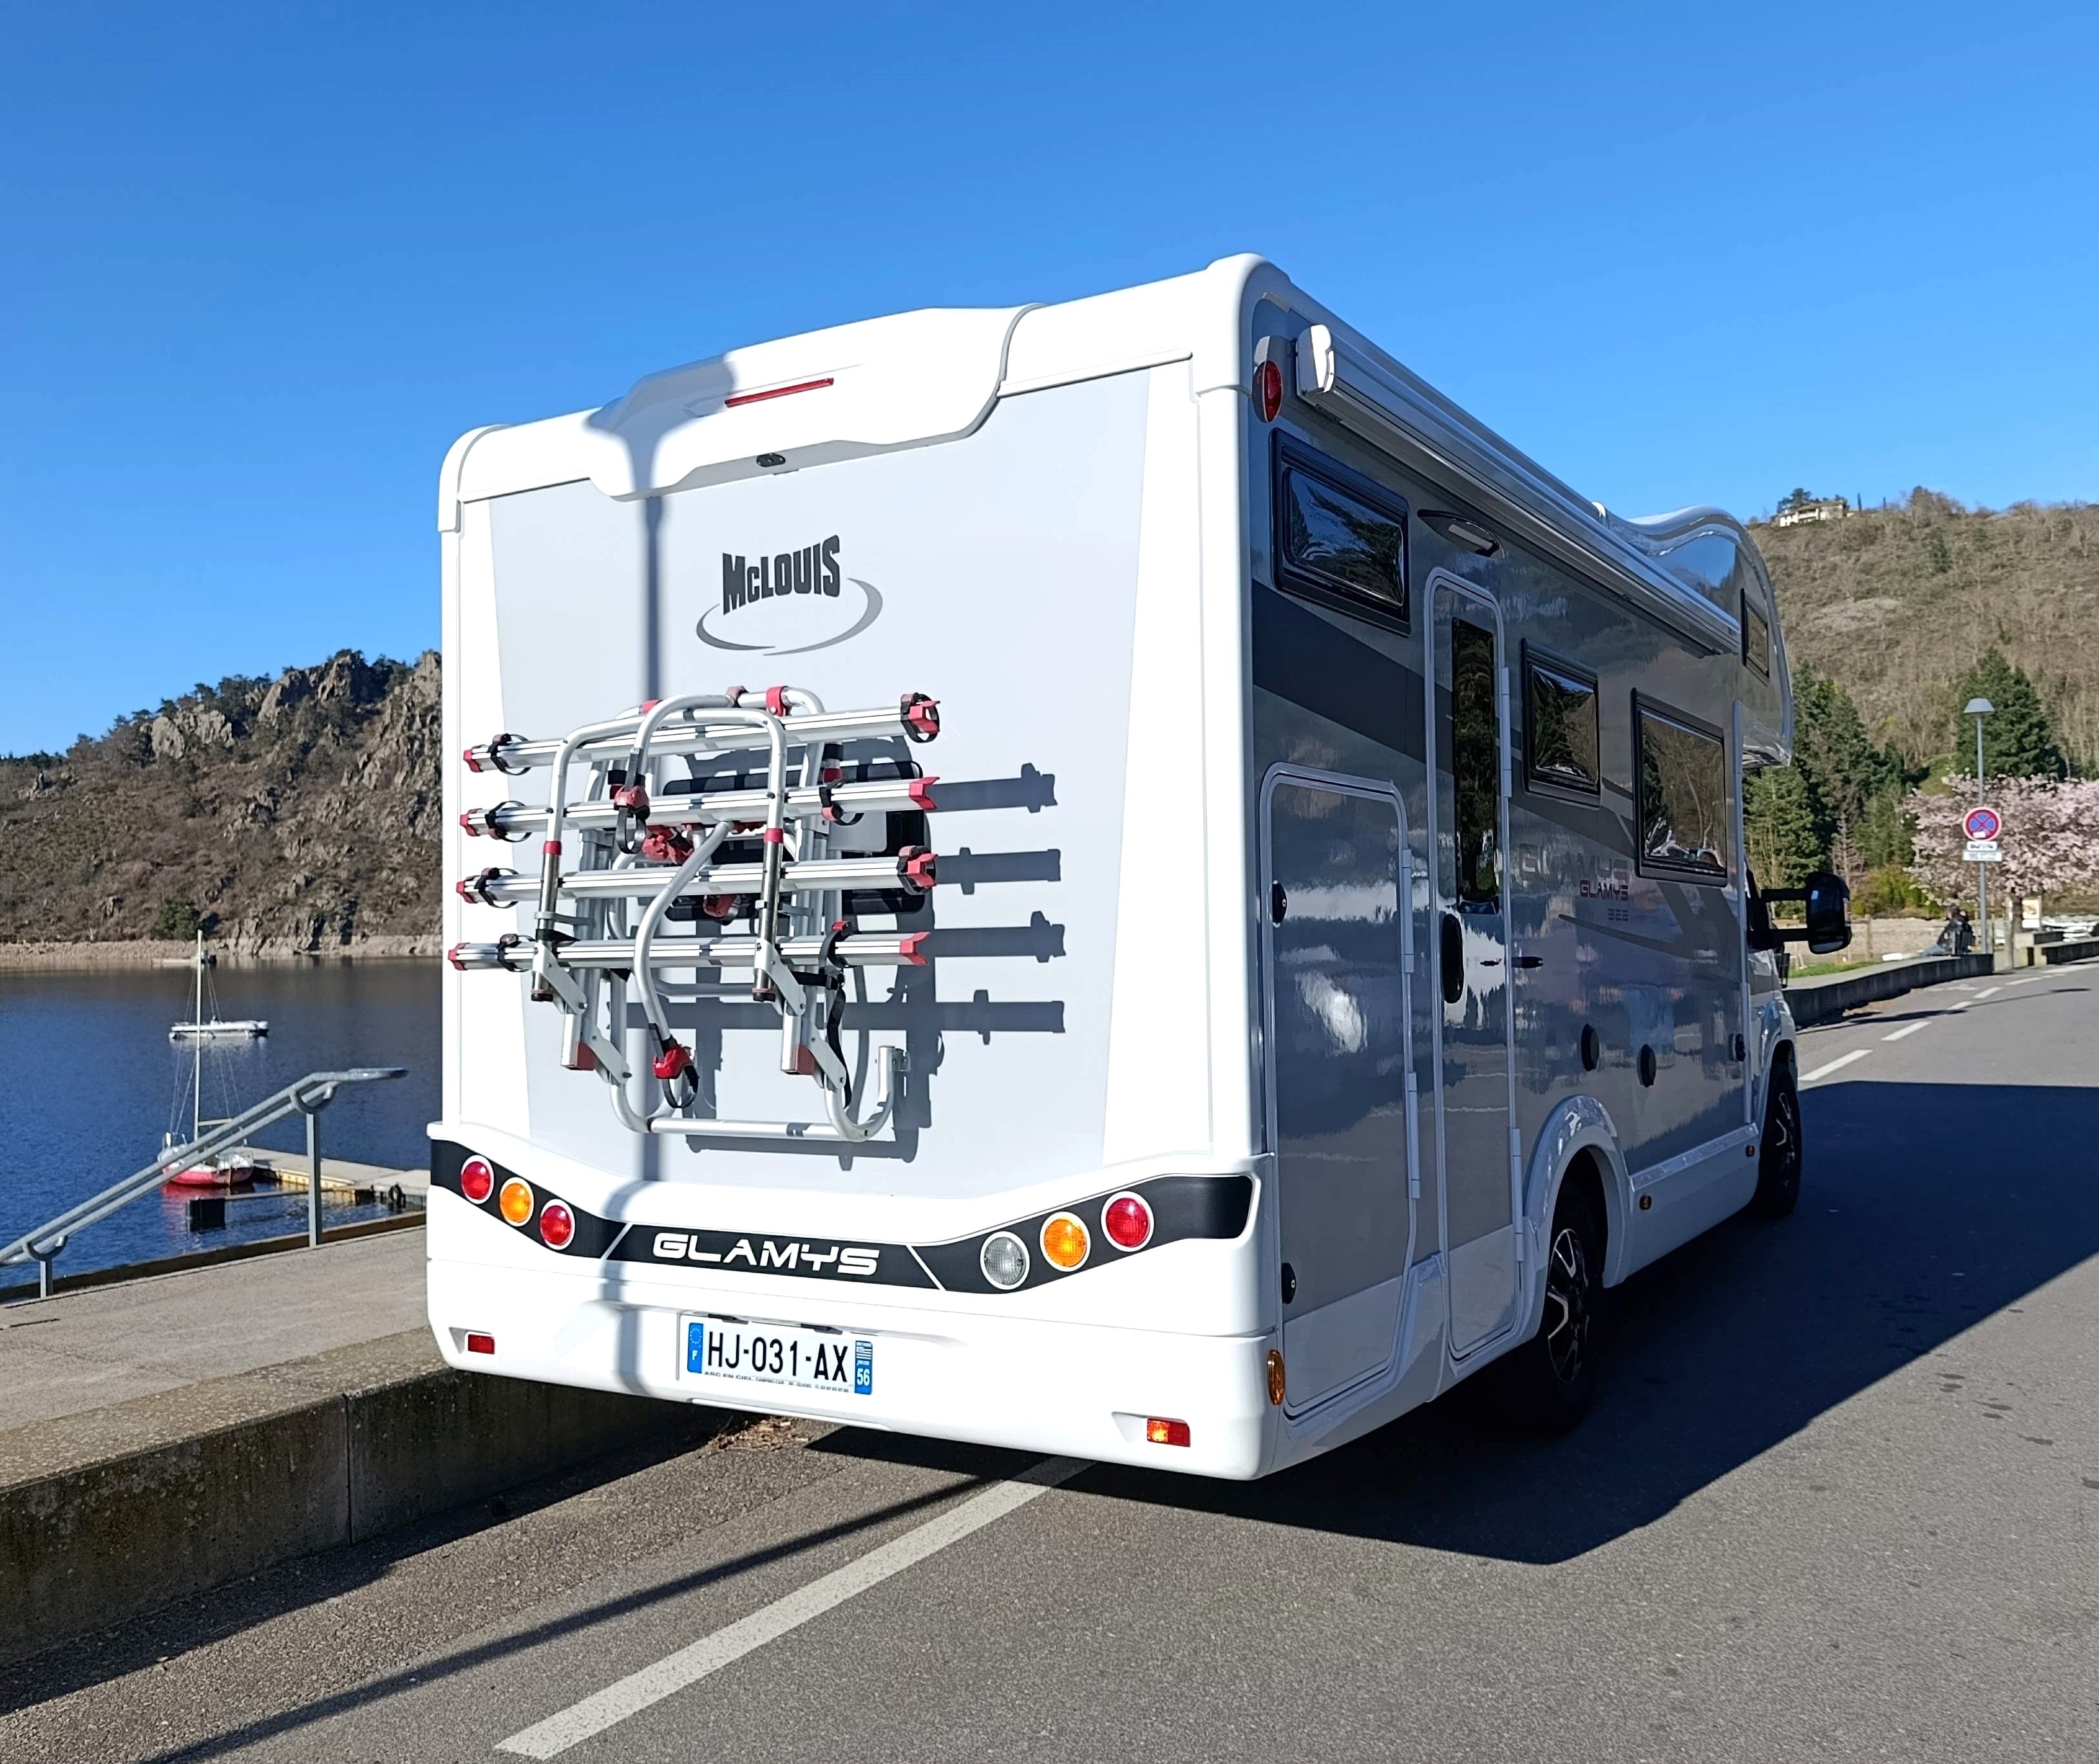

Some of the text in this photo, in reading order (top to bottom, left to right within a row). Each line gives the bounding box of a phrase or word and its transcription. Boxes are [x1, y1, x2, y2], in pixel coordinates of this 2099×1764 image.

[1580, 879, 1629, 902] GLAMYS
[652, 1232, 880, 1276] GLAMYS
[692, 1349, 698, 1361] F
[707, 1331, 849, 1383] HJ-031-AX
[857, 1367, 870, 1387] 56
